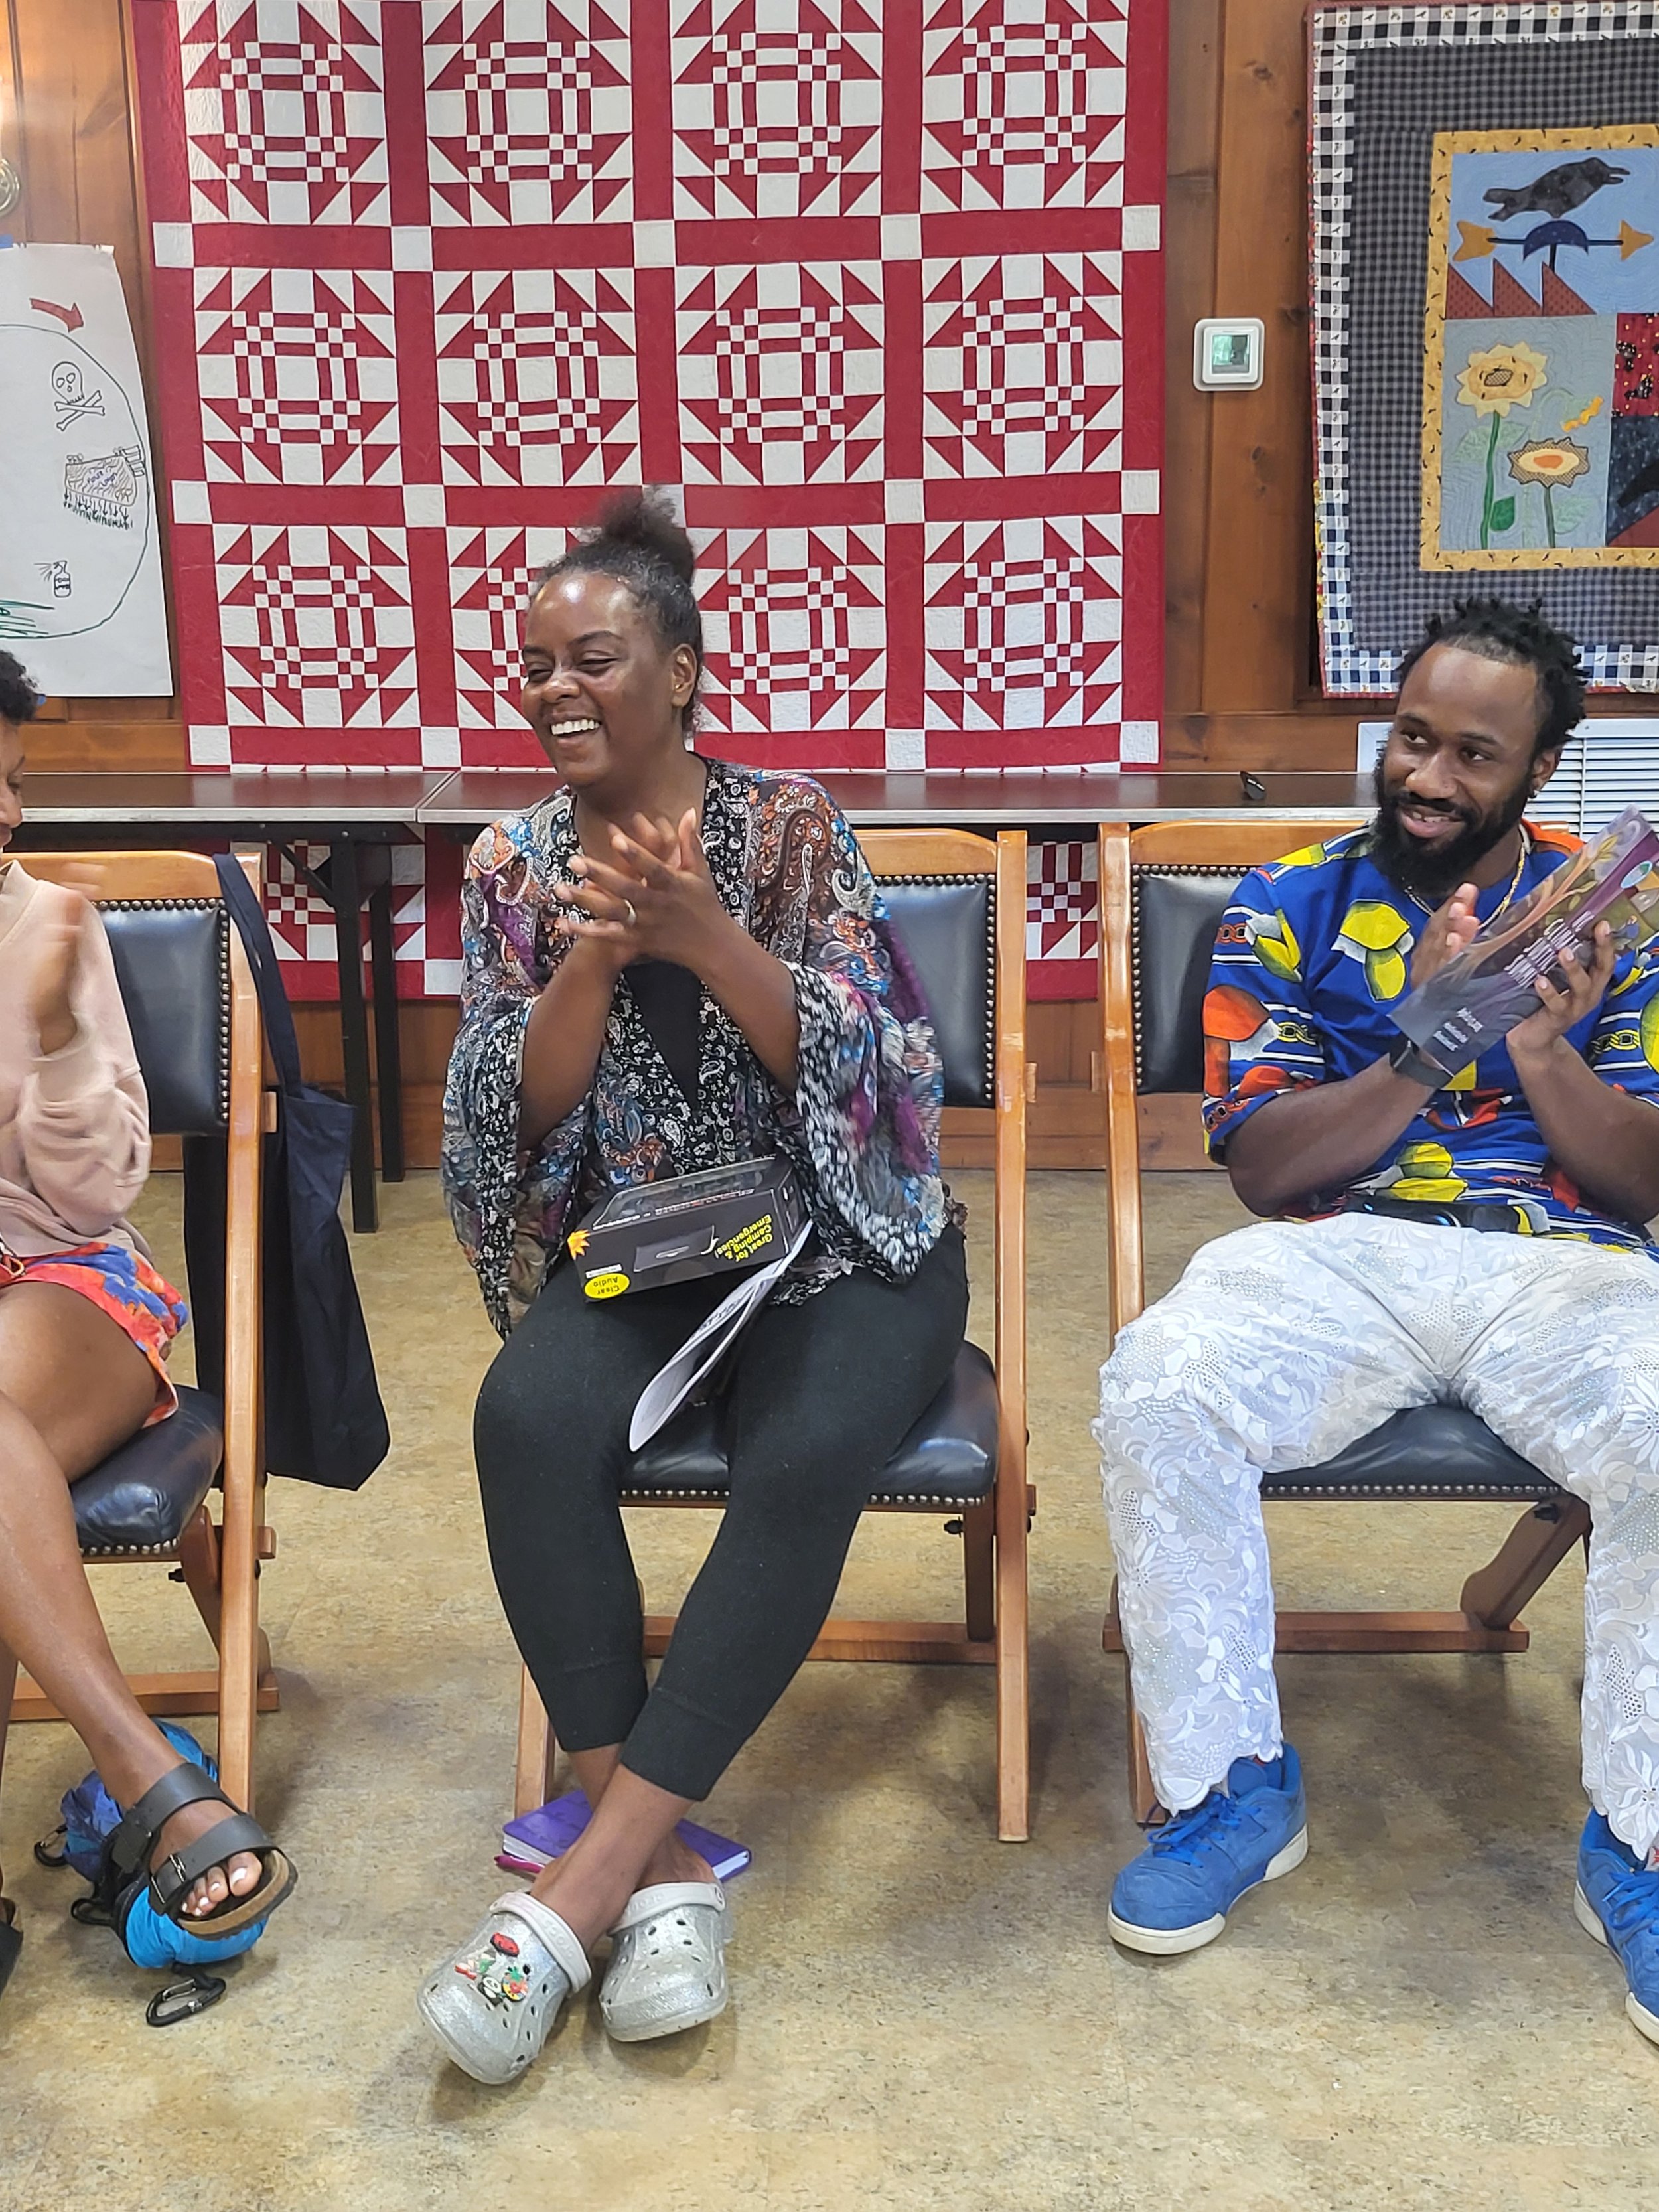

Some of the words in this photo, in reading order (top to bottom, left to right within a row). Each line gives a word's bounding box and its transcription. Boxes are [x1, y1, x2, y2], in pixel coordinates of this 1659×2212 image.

[715, 1214, 772, 1258] Emergencies!
[733, 1224, 772, 1252] Camping
[749, 1233, 773, 1254] Great
[735, 1249, 749, 1262] for
[593, 1276, 618, 1287] Audio
[598, 1285, 620, 1295] Clear
